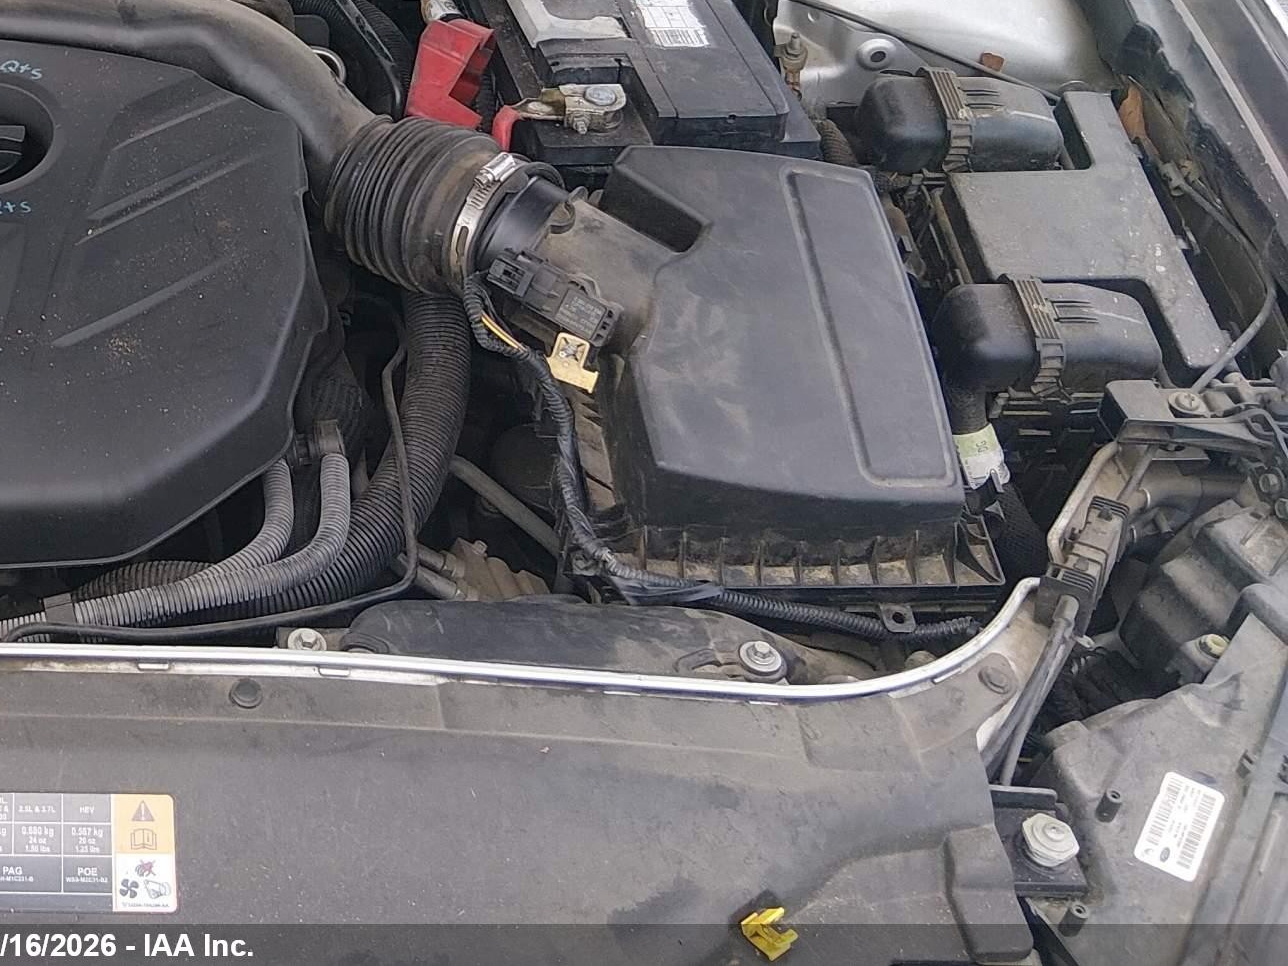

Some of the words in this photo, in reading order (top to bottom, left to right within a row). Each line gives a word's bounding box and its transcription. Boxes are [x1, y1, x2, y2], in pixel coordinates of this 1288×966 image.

[0, 59, 43, 80] Qts
[44, 825, 54, 838] kg
[93, 826, 104, 838] kg
[28, 835, 38, 844] 24
[78, 836, 87, 844] 20
[40, 844, 51, 852] lbs
[2, 866, 23, 876] PAG
[77, 867, 98, 877] POE
